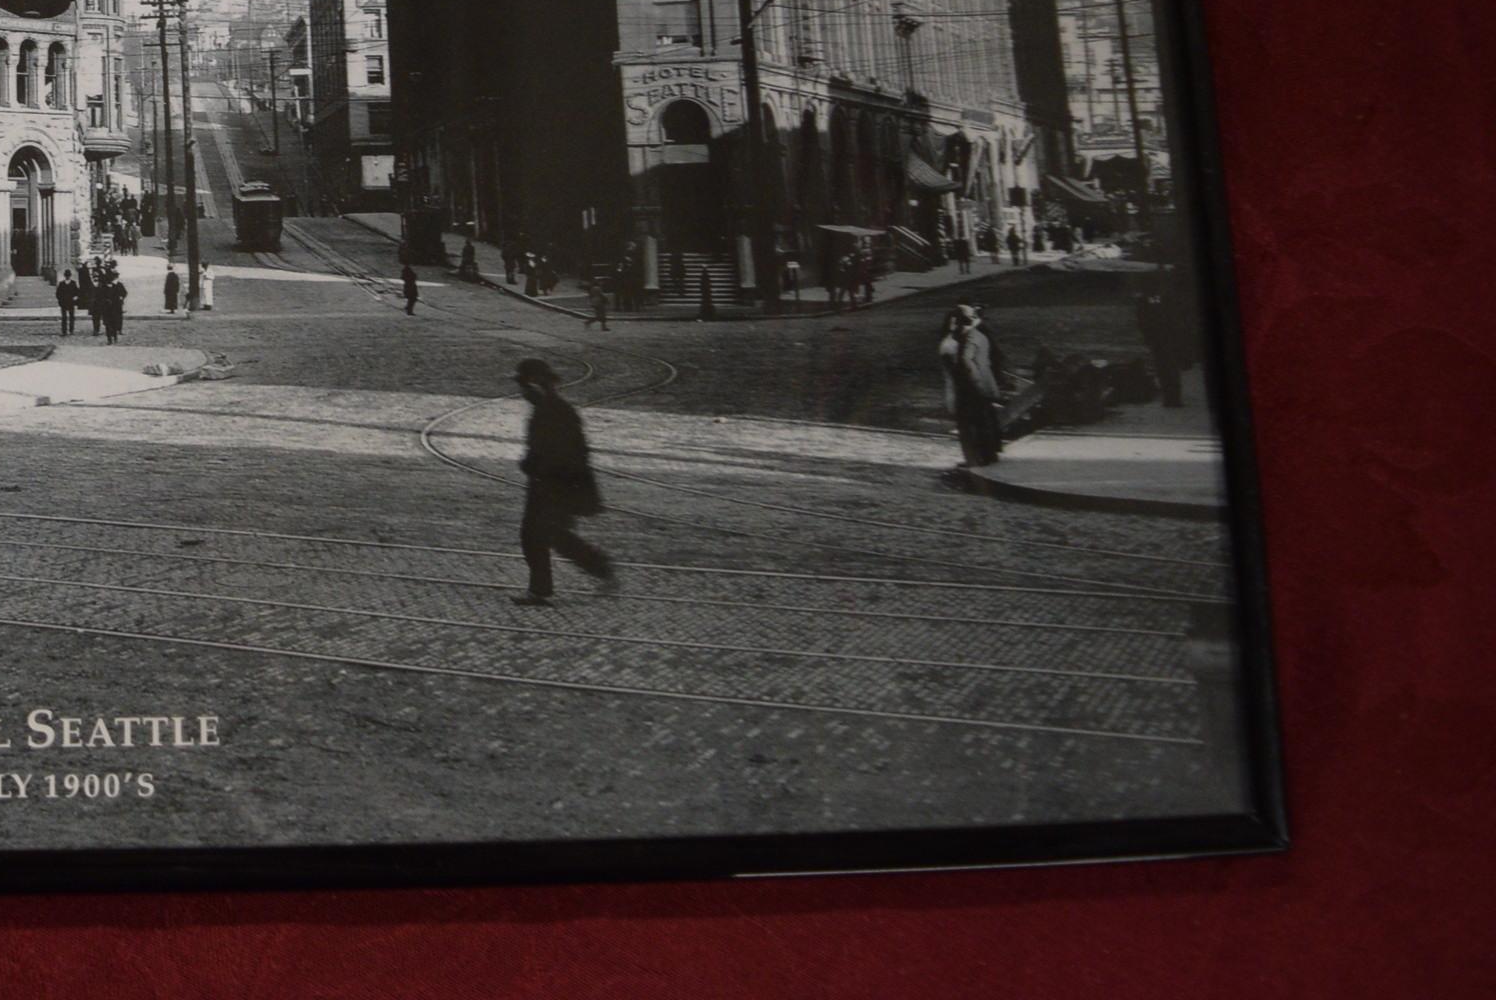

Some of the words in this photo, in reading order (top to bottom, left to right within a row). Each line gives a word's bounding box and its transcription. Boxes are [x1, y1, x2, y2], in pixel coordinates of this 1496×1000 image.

[641, 66, 720, 85] HOTEL
[623, 82, 742, 127] SEATTLE
[26, 708, 222, 750] SEATTLE
[44, 771, 157, 799] 1900'S
